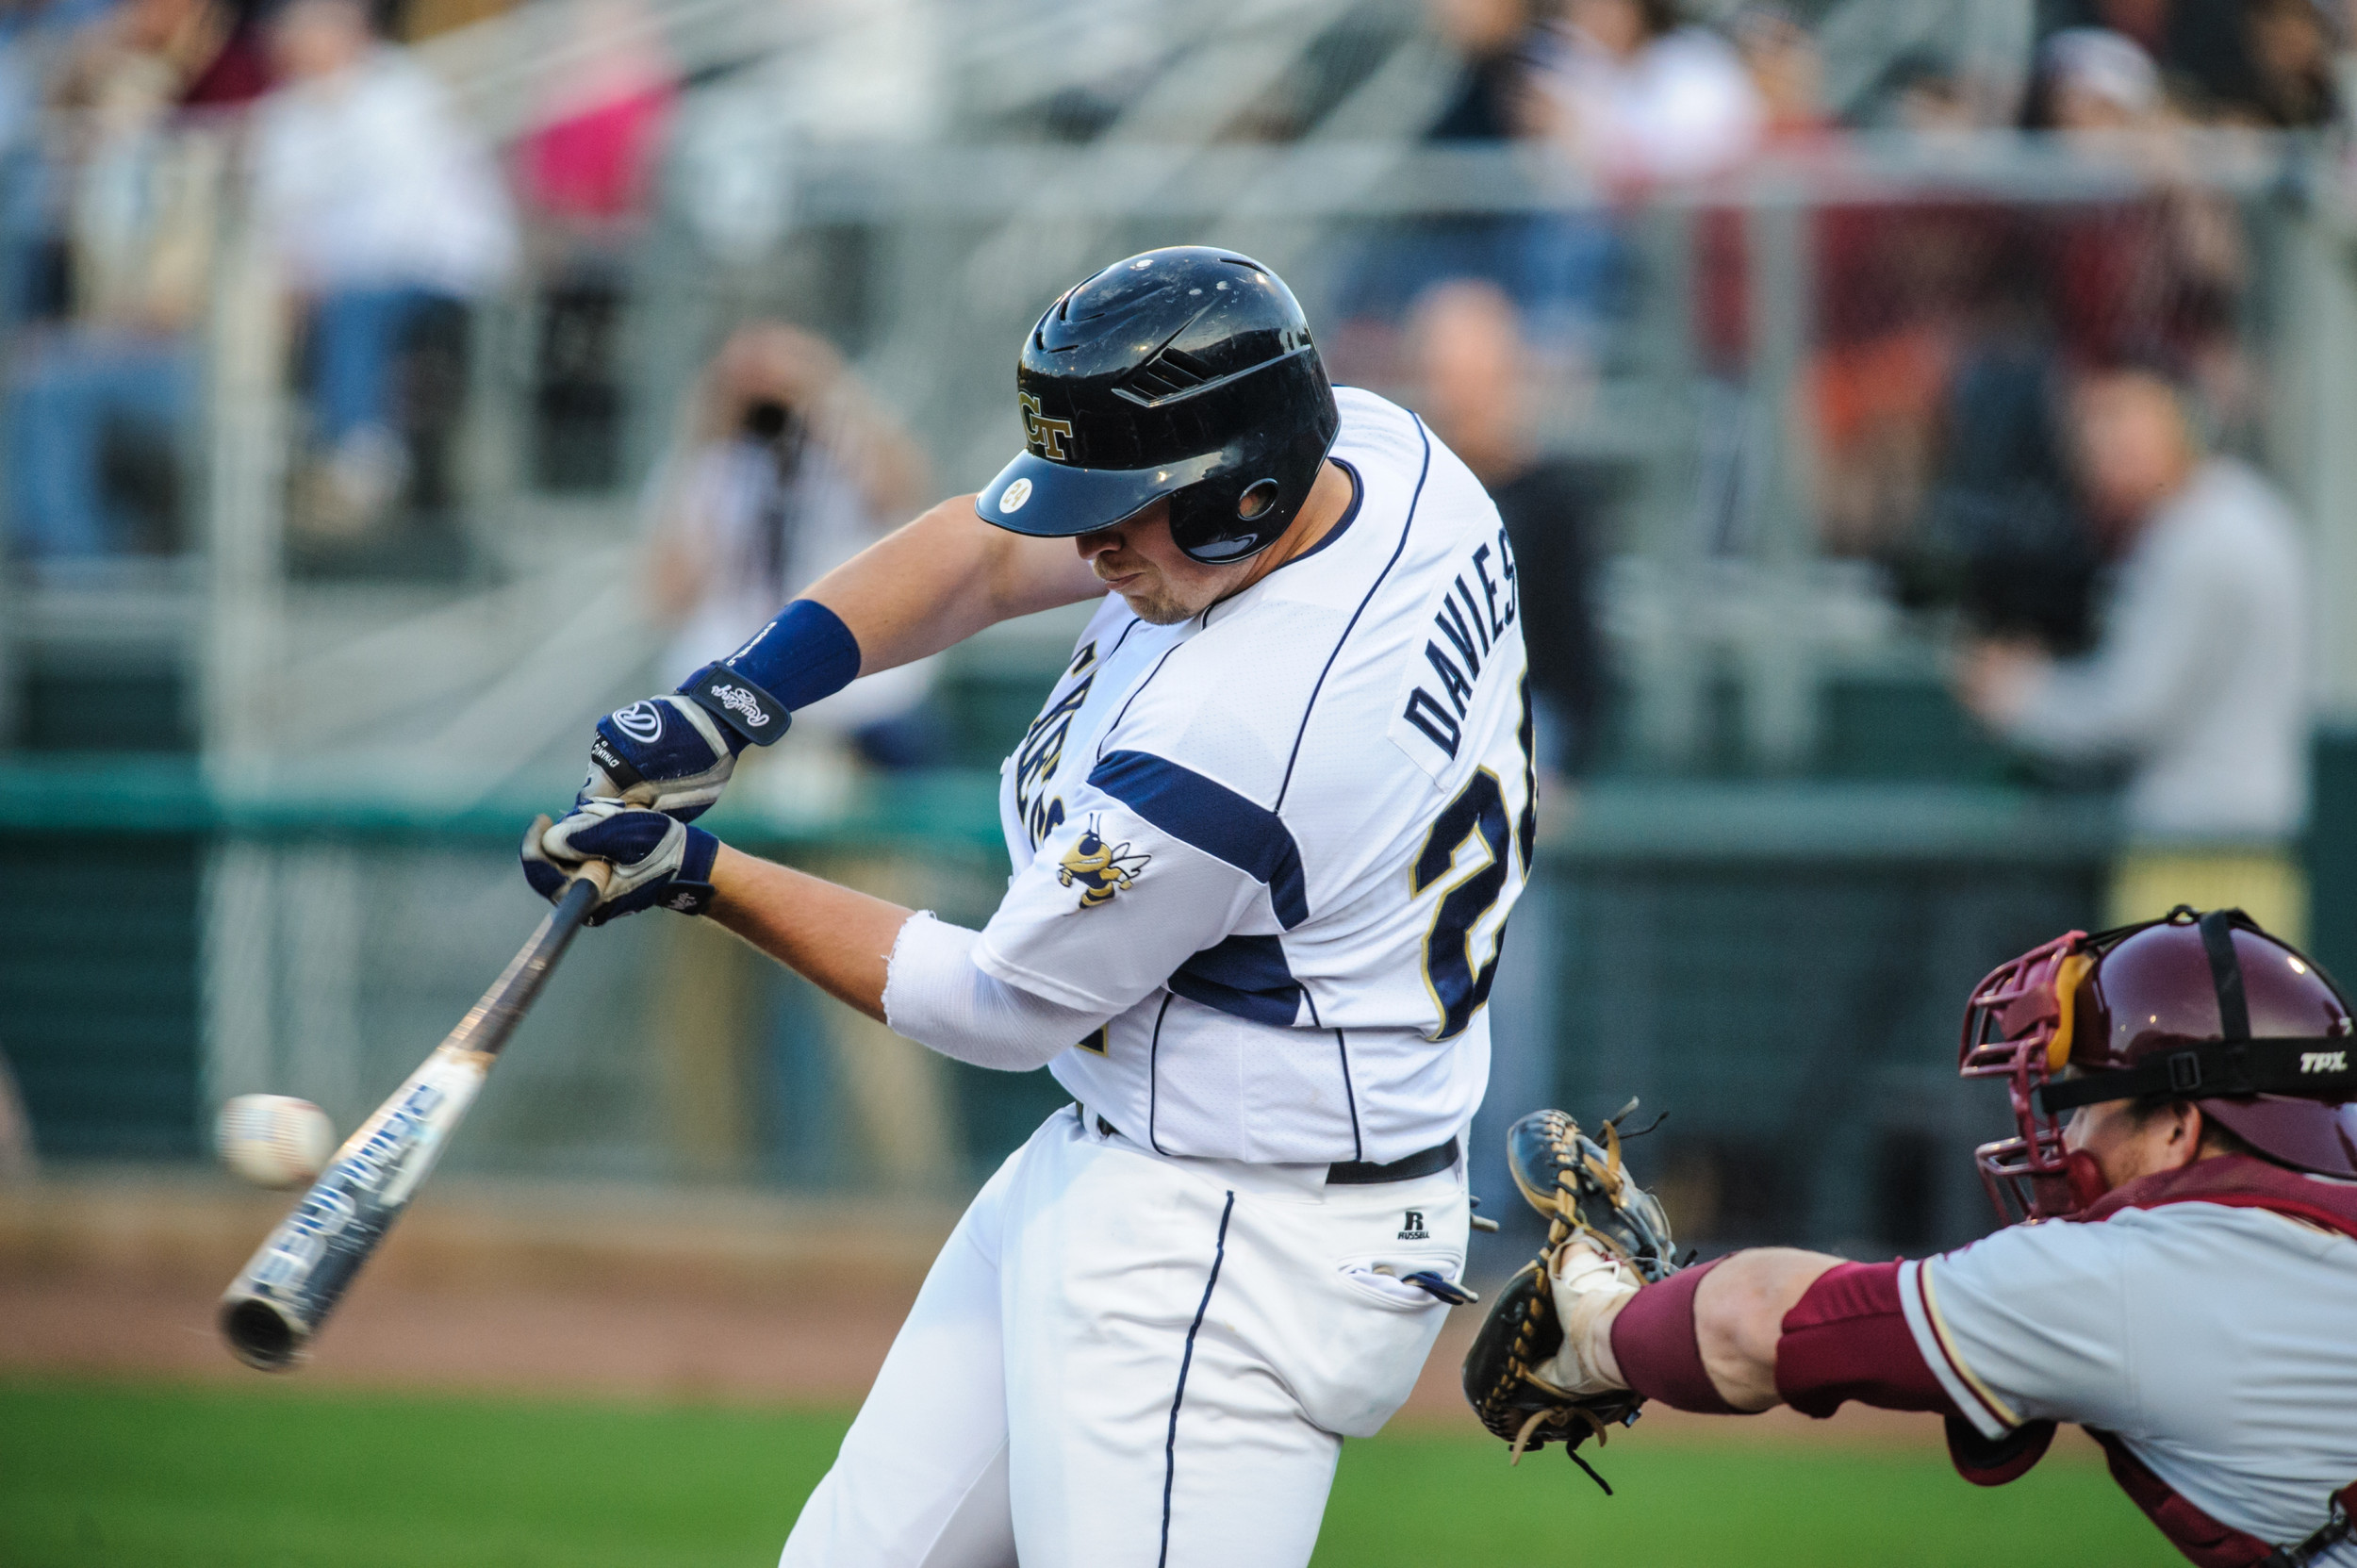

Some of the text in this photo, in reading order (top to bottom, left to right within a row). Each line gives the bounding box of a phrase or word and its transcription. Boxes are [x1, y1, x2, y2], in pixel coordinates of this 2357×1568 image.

[1018, 391, 1073, 460] GT
[1002, 482, 1030, 508] 24
[1403, 526, 1517, 761] DAVIES
[710, 684, 770, 727] Rawlings
[591, 743, 620, 768] DYNAMIC
[1404, 1211, 1424, 1231] R
[1397, 1231, 1430, 1240] RUSSELL
